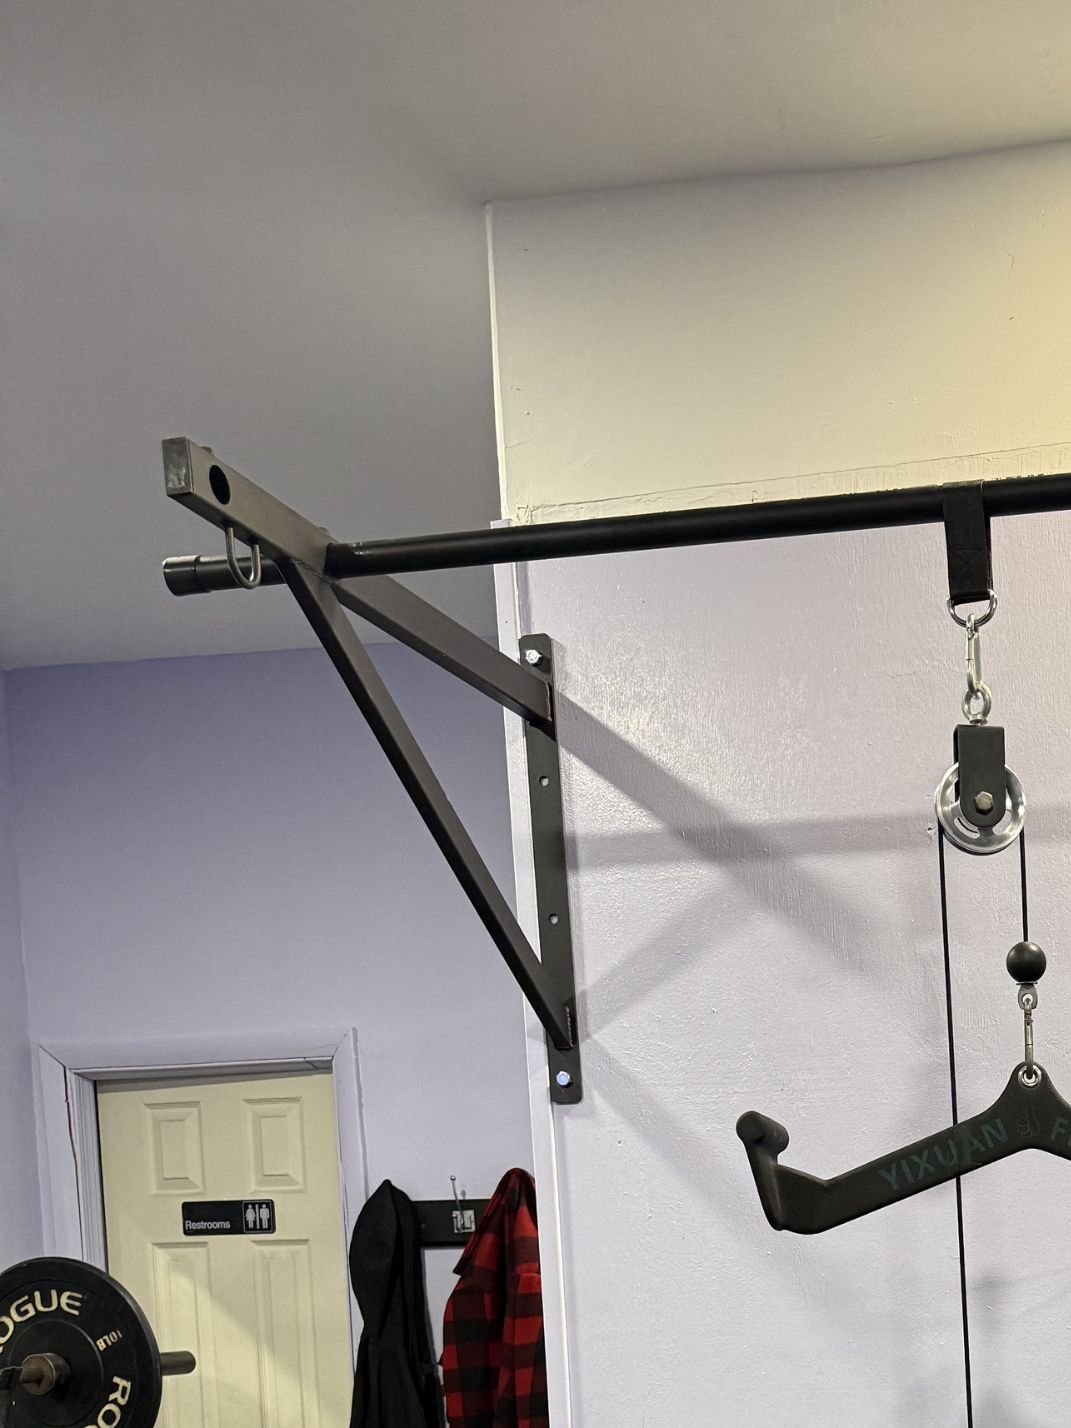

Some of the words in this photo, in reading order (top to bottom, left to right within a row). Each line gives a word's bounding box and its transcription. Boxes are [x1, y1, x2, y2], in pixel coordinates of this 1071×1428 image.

[879, 1118, 1009, 1191] YIXUAN
[185, 1221, 230, 1230] Restrooms
[0, 1289, 82, 1350] OGUE
[96, 1329, 122, 1351] 10LB
